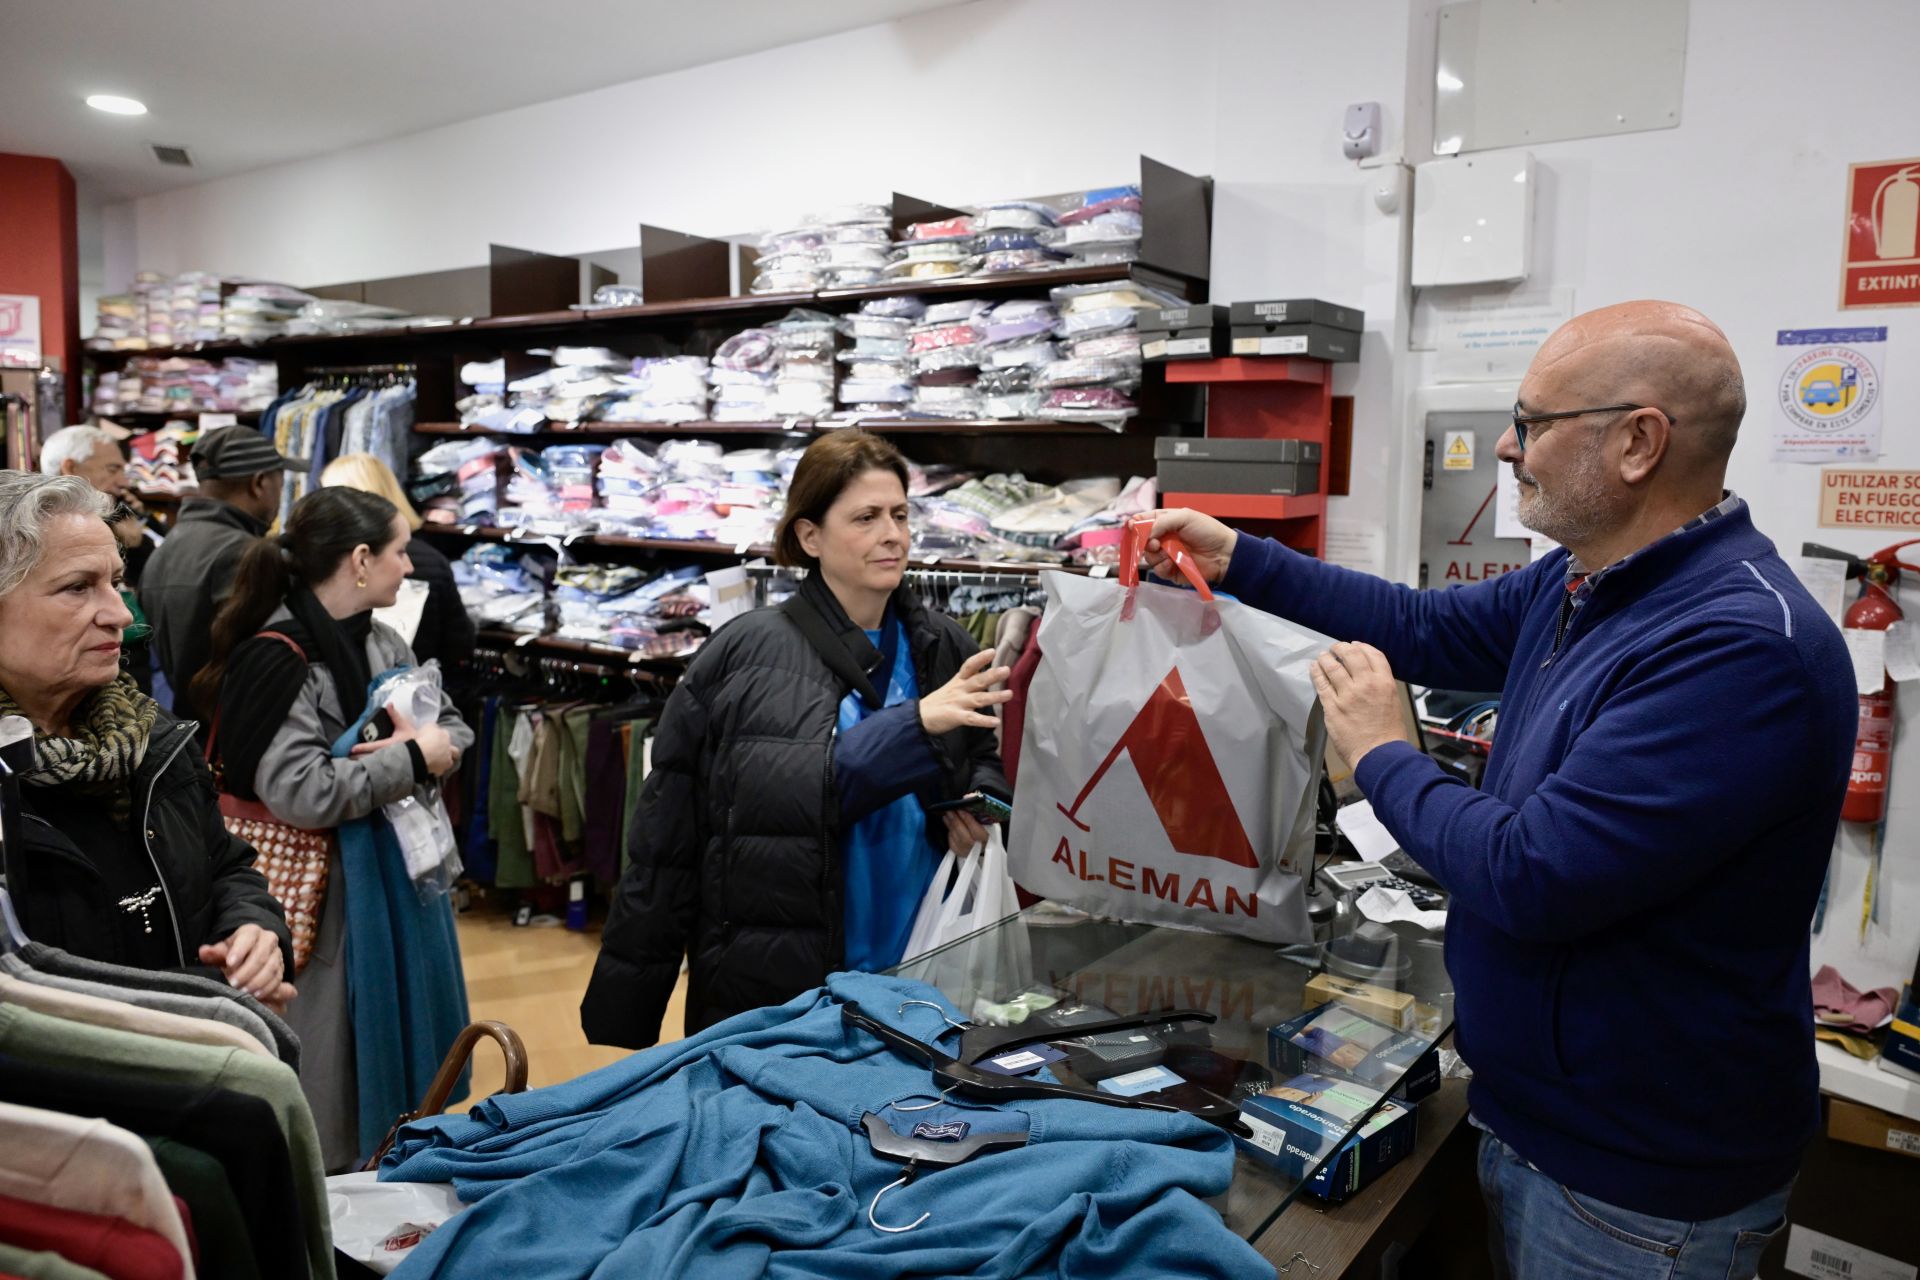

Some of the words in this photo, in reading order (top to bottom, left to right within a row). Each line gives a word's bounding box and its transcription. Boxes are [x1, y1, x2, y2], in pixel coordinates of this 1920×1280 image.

[1857, 274, 1920, 292] EXTINT
[1827, 474, 1899, 489] UTILIZAR
[1838, 492, 1861, 505] EN
[1051, 835, 1259, 919] ALEMAN
